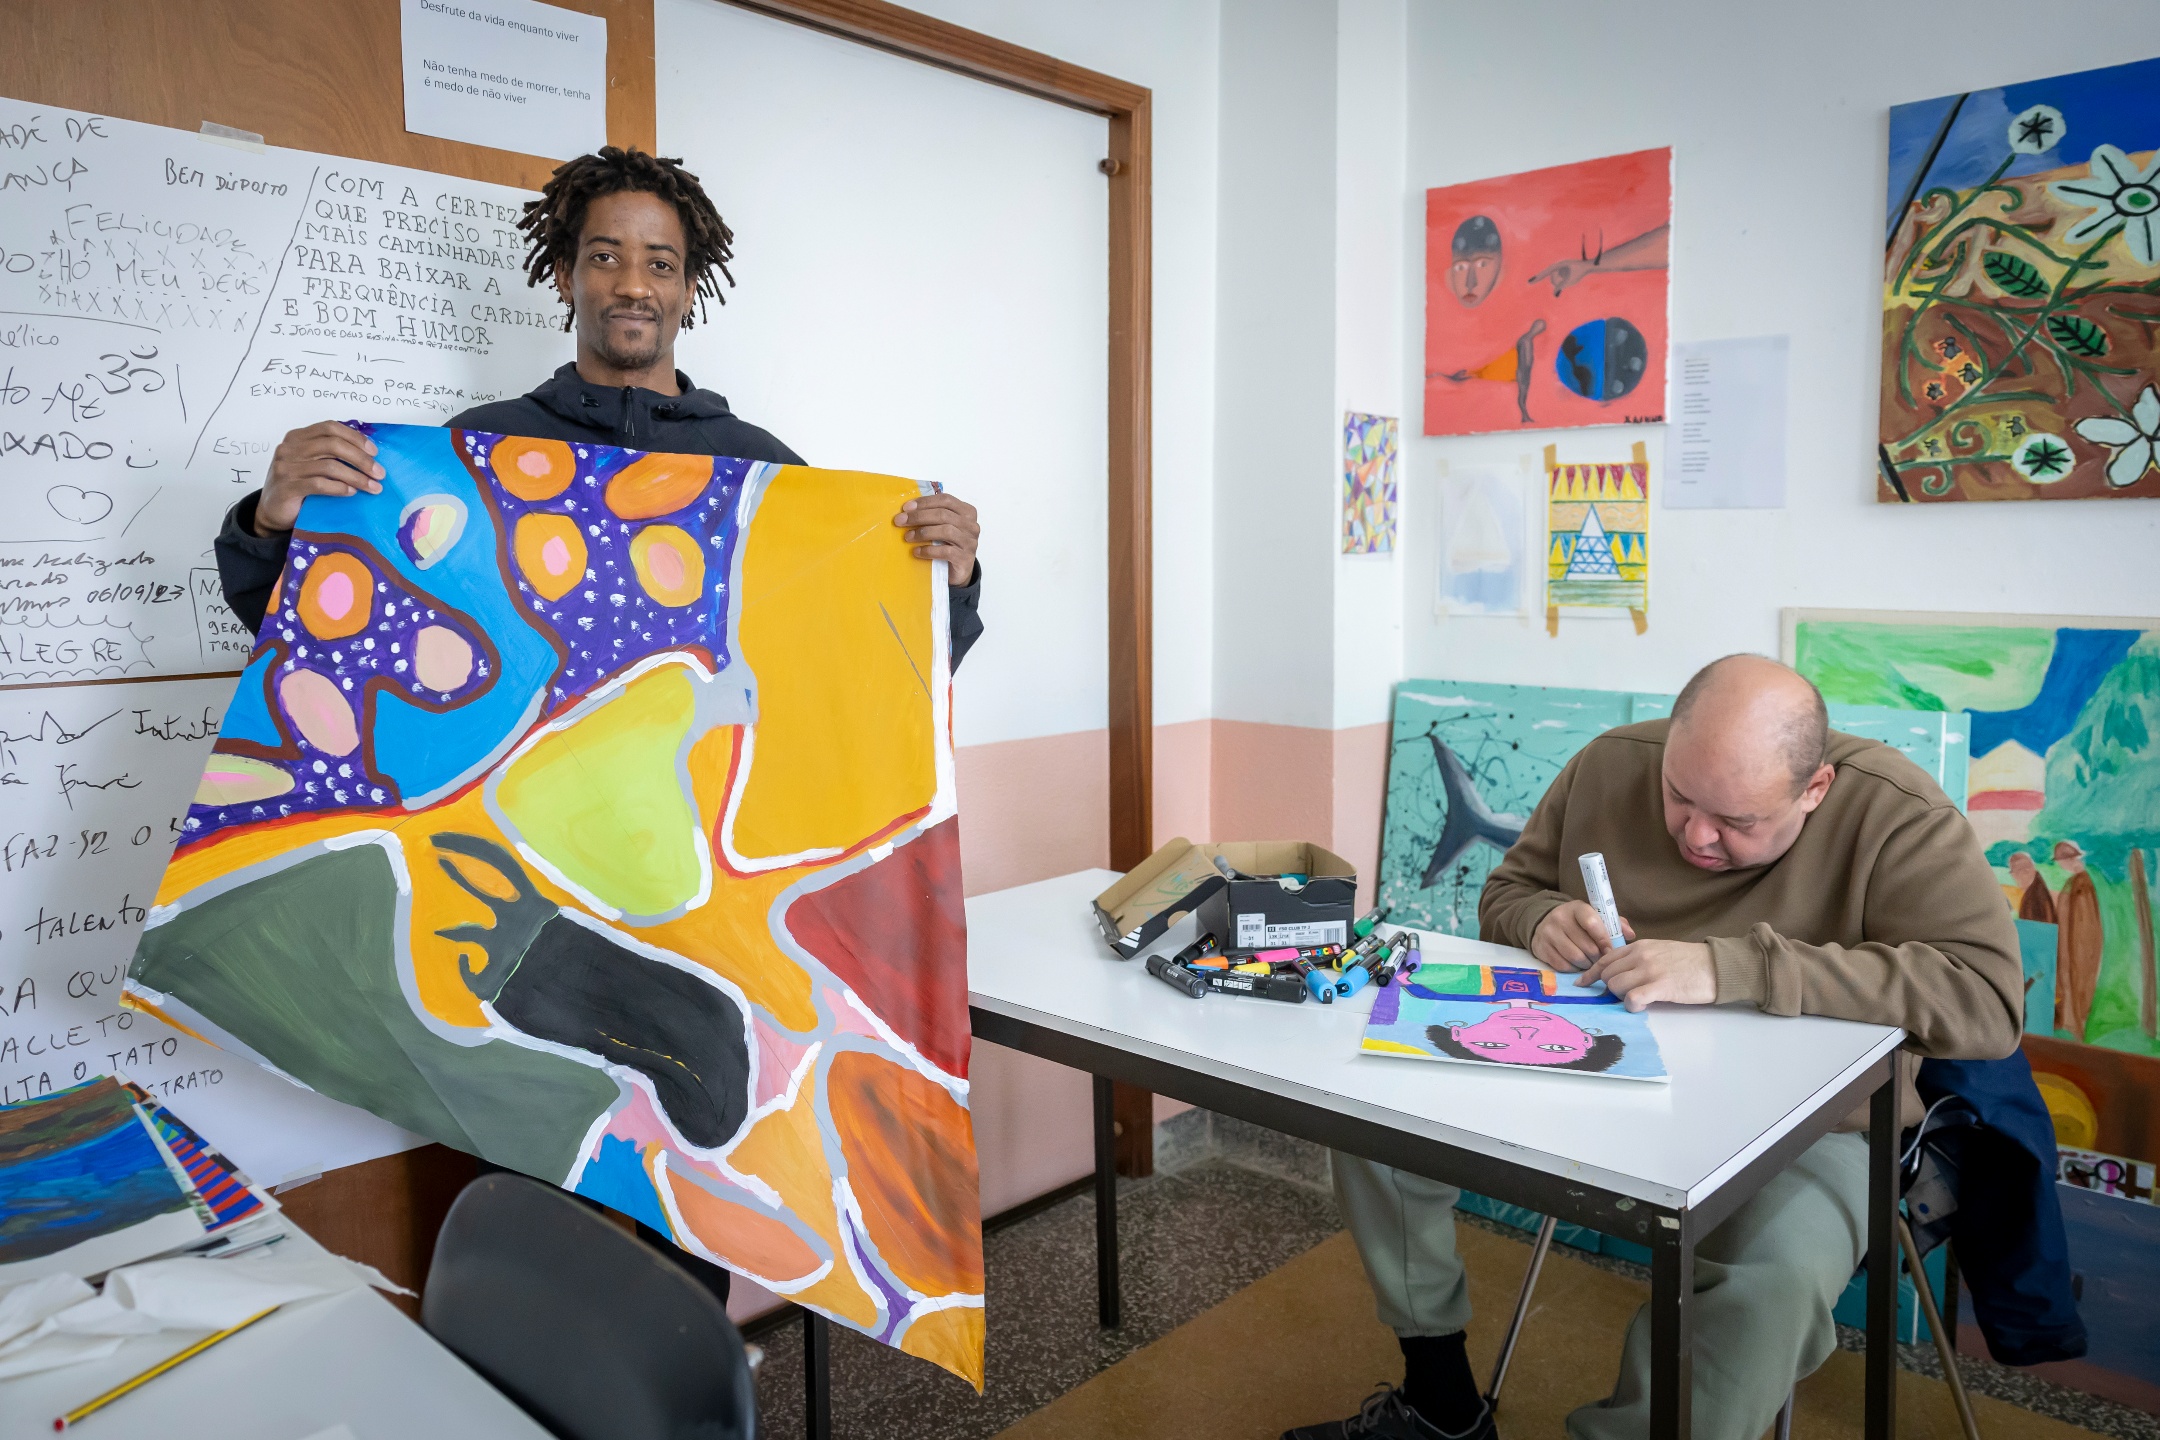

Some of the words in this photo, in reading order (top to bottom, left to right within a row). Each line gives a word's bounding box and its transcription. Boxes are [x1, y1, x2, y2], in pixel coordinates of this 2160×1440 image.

[421, 0, 466, 18] Desfrute
[468, 11, 482, 21] da
[484, 14, 505, 26] vida
[507, 20, 554, 38] enquanto
[556, 30, 579, 43] viver
[423, 59, 445, 73] Não
[447, 65, 477, 79] tenha
[480, 71, 509, 85] medo
[511, 77, 524, 88] de
[526, 81, 561, 96] morrer,
[563, 87, 591, 101] tenha
[424, 76, 431, 87] é
[434, 81, 464, 94] medo
[466, 85, 479, 96] de
[482, 88, 501, 100] não
[503, 92, 527, 105] viver
[165, 158, 204, 188] BEM
[315, 200, 367, 224] QUE
[325, 171, 384, 200] COM
[400, 186, 419, 207] A
[435, 193, 519, 225] CERTEZ
[294, 245, 366, 275] PARA
[484, 277, 502, 296] A
[283, 299, 299, 317] E
[313, 301, 377, 328] BOM
[395, 315, 494, 345] HUMOR
[313, 389, 368, 403] DENTRO
[384, 379, 416, 392] POR
[0, 1071, 52, 1105] LTA
[73, 1061, 87, 1081] O
[107, 1037, 177, 1071] TATO
